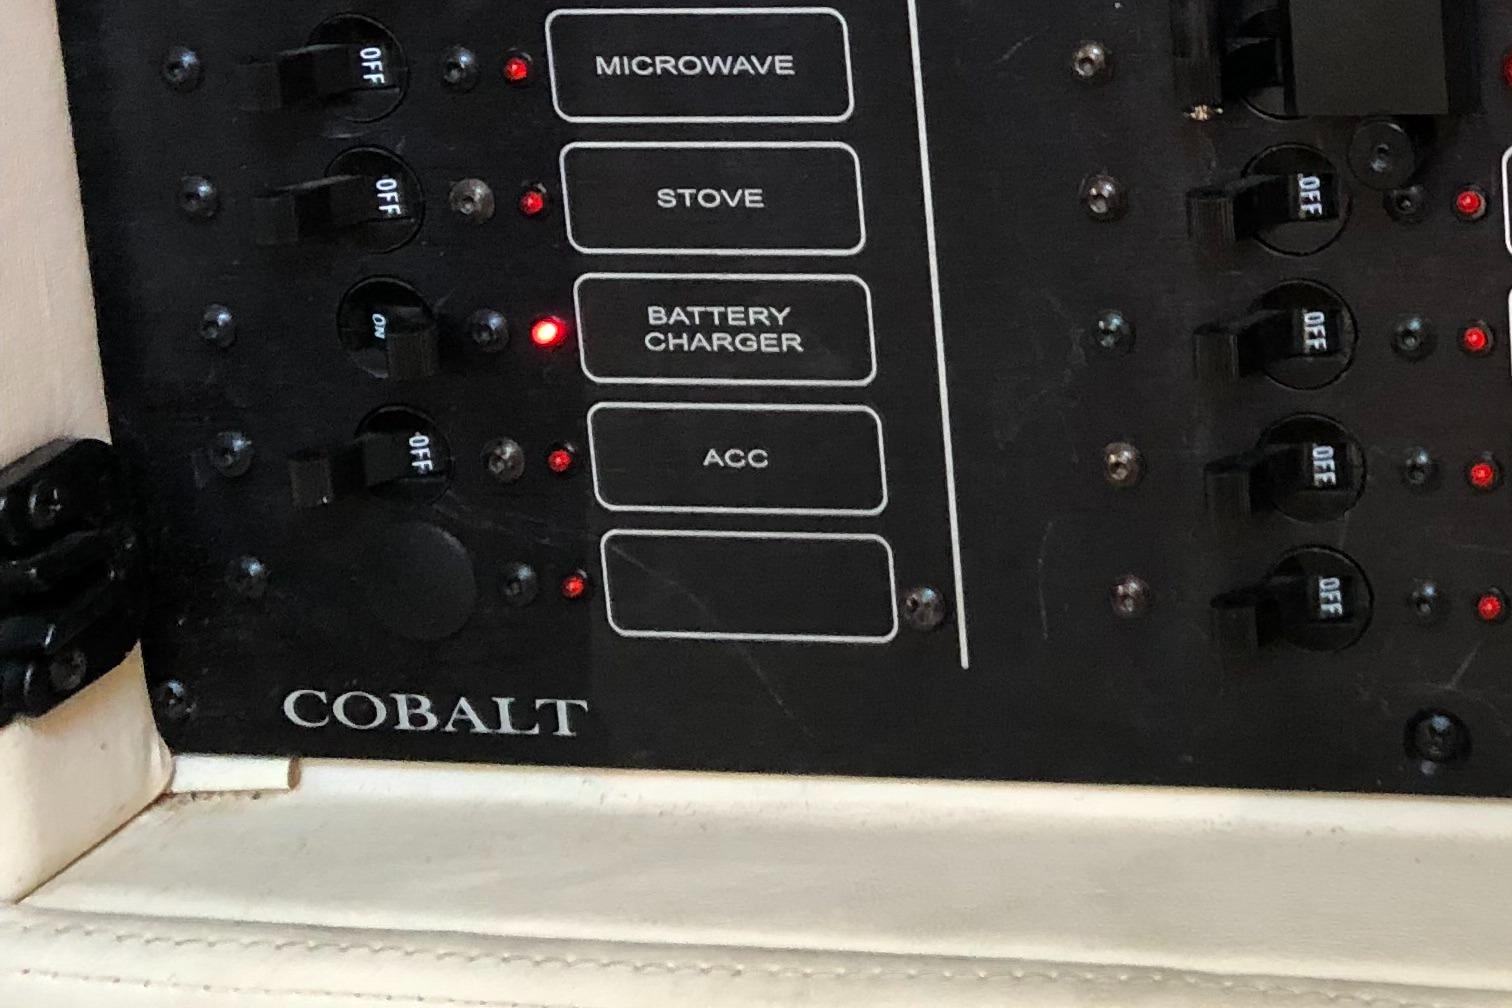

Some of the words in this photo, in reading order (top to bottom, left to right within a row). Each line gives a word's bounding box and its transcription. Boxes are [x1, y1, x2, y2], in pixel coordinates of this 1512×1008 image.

[359, 47, 386, 84] OFF
[595, 55, 796, 76] MICROWAVE
[375, 178, 402, 215] OFF
[657, 188, 765, 208] STOVE
[1299, 174, 1323, 215] OFF
[371, 313, 387, 339] ON
[647, 305, 791, 327] BATTERY
[1303, 311, 1327, 350] OFF
[644, 331, 804, 353] CHARGER
[408, 433, 434, 473] OFF
[702, 448, 769, 469] ACC
[1312, 443, 1337, 486] OFF
[1318, 577, 1343, 615] OFF
[283, 689, 589, 737] COBALT
